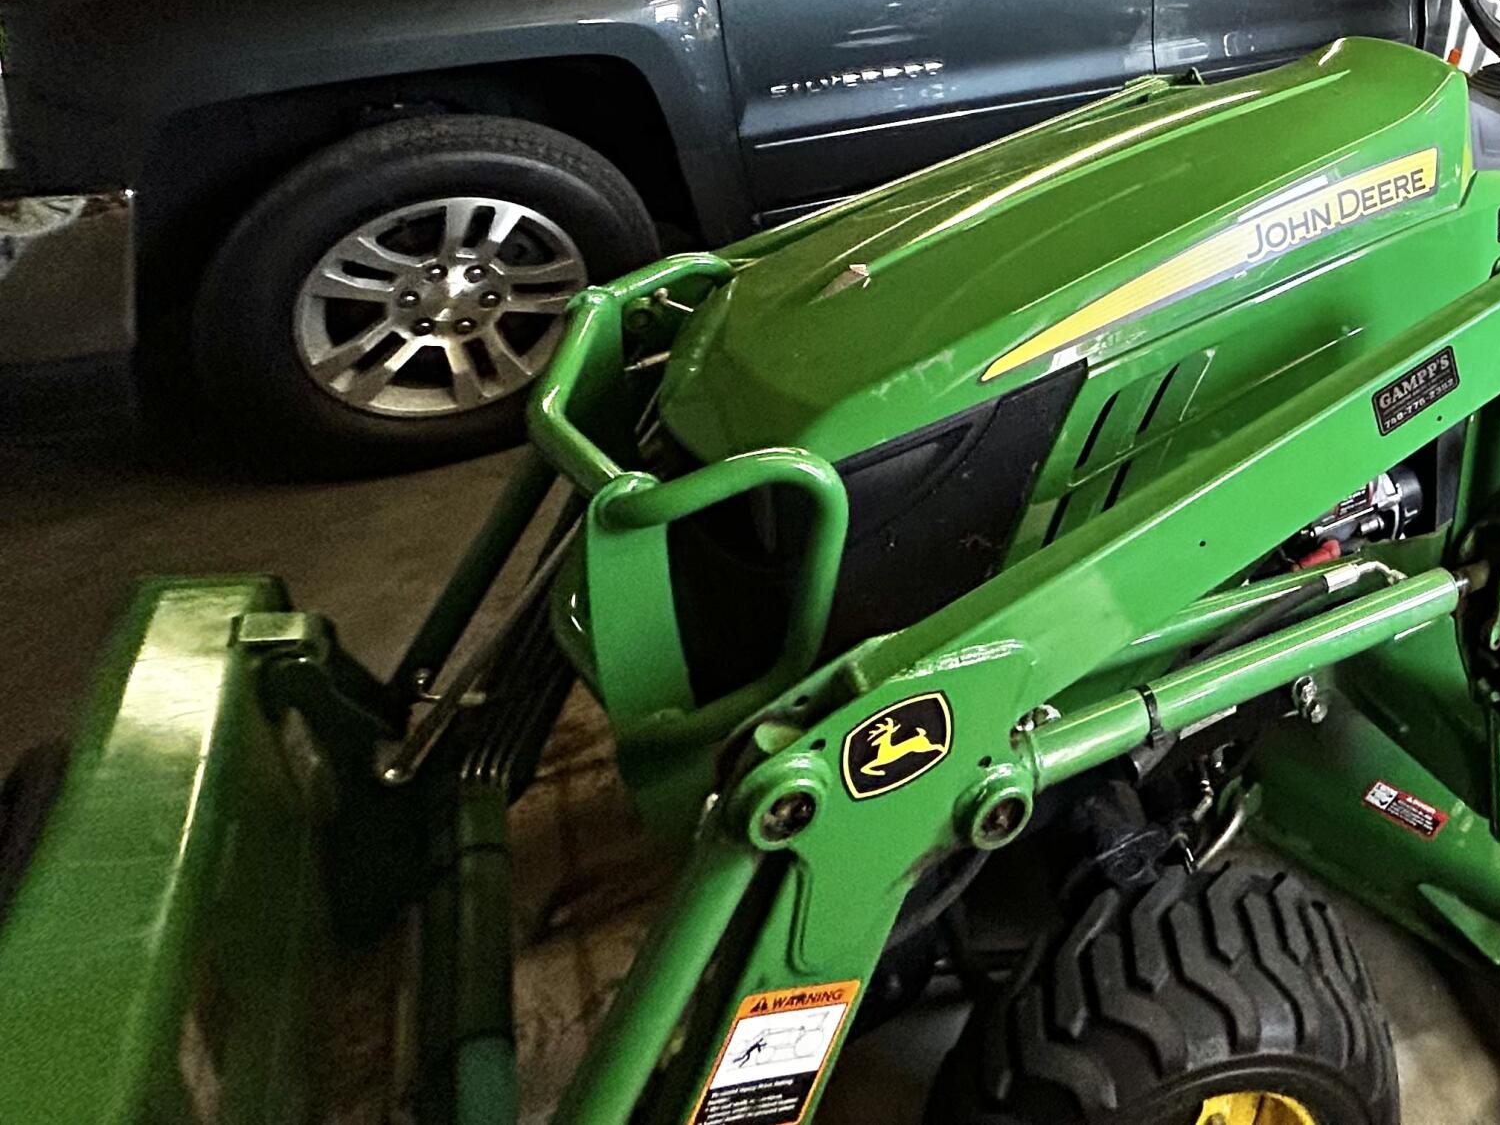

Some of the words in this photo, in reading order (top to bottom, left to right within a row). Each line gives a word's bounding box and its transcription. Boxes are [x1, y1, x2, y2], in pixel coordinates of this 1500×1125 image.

[1247, 203, 1332, 260] JOHN
[1337, 169, 1426, 220] DEERE
[1380, 355, 1450, 408] GAMPP'S
[772, 989, 846, 1010] WARNING
